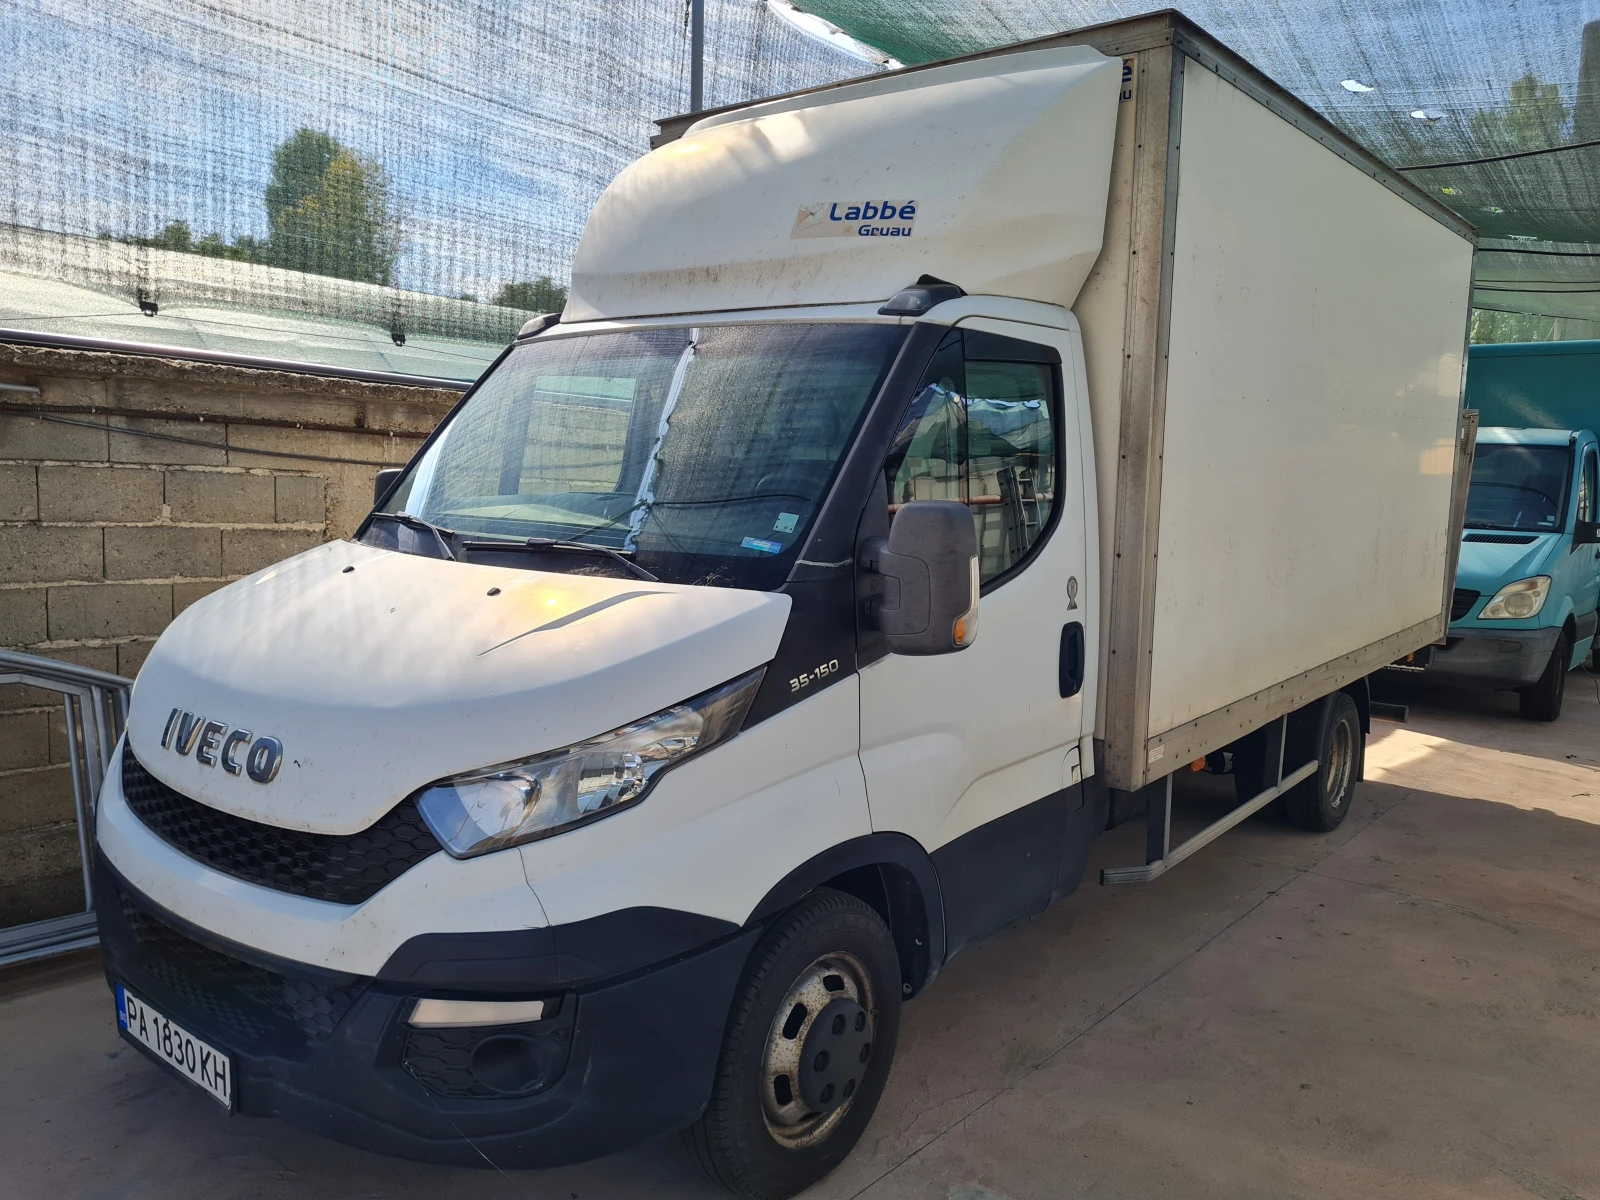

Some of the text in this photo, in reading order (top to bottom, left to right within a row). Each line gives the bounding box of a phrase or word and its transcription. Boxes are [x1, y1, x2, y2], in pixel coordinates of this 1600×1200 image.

[829, 200, 916, 221] Labbé
[858, 224, 912, 237] Gruau
[789, 659, 839, 693] 35-150
[160, 707, 284, 784] IVECO
[126, 995, 227, 1097] PA 1830 KH
